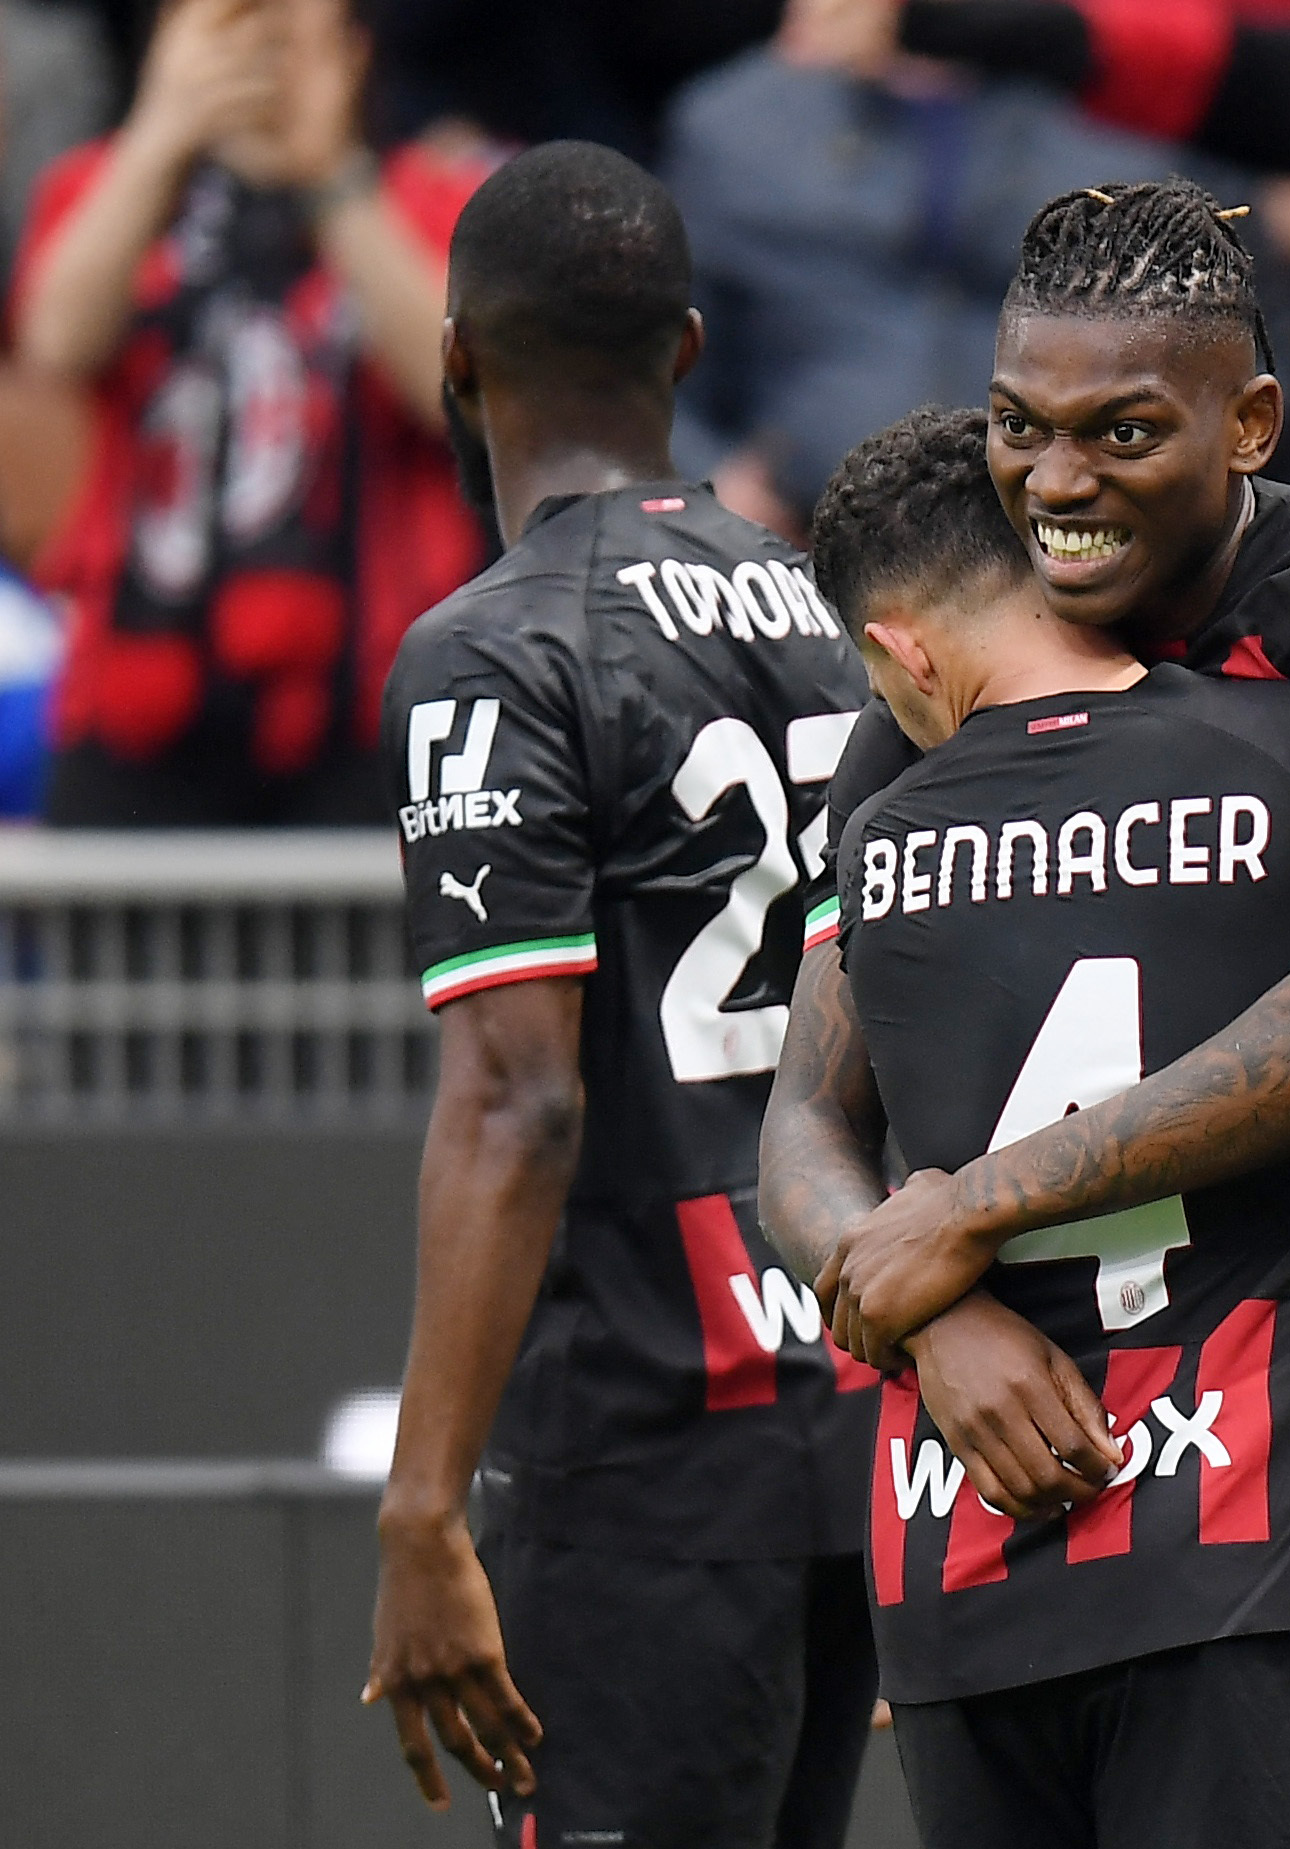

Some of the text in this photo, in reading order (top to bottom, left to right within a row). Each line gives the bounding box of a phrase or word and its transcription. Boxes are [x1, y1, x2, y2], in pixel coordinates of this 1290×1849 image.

[398, 788, 524, 843] BitMEX
[862, 795, 1272, 921] BENNACER
[986, 957, 1191, 1331] 4
[890, 1390, 1231, 1520] wox
